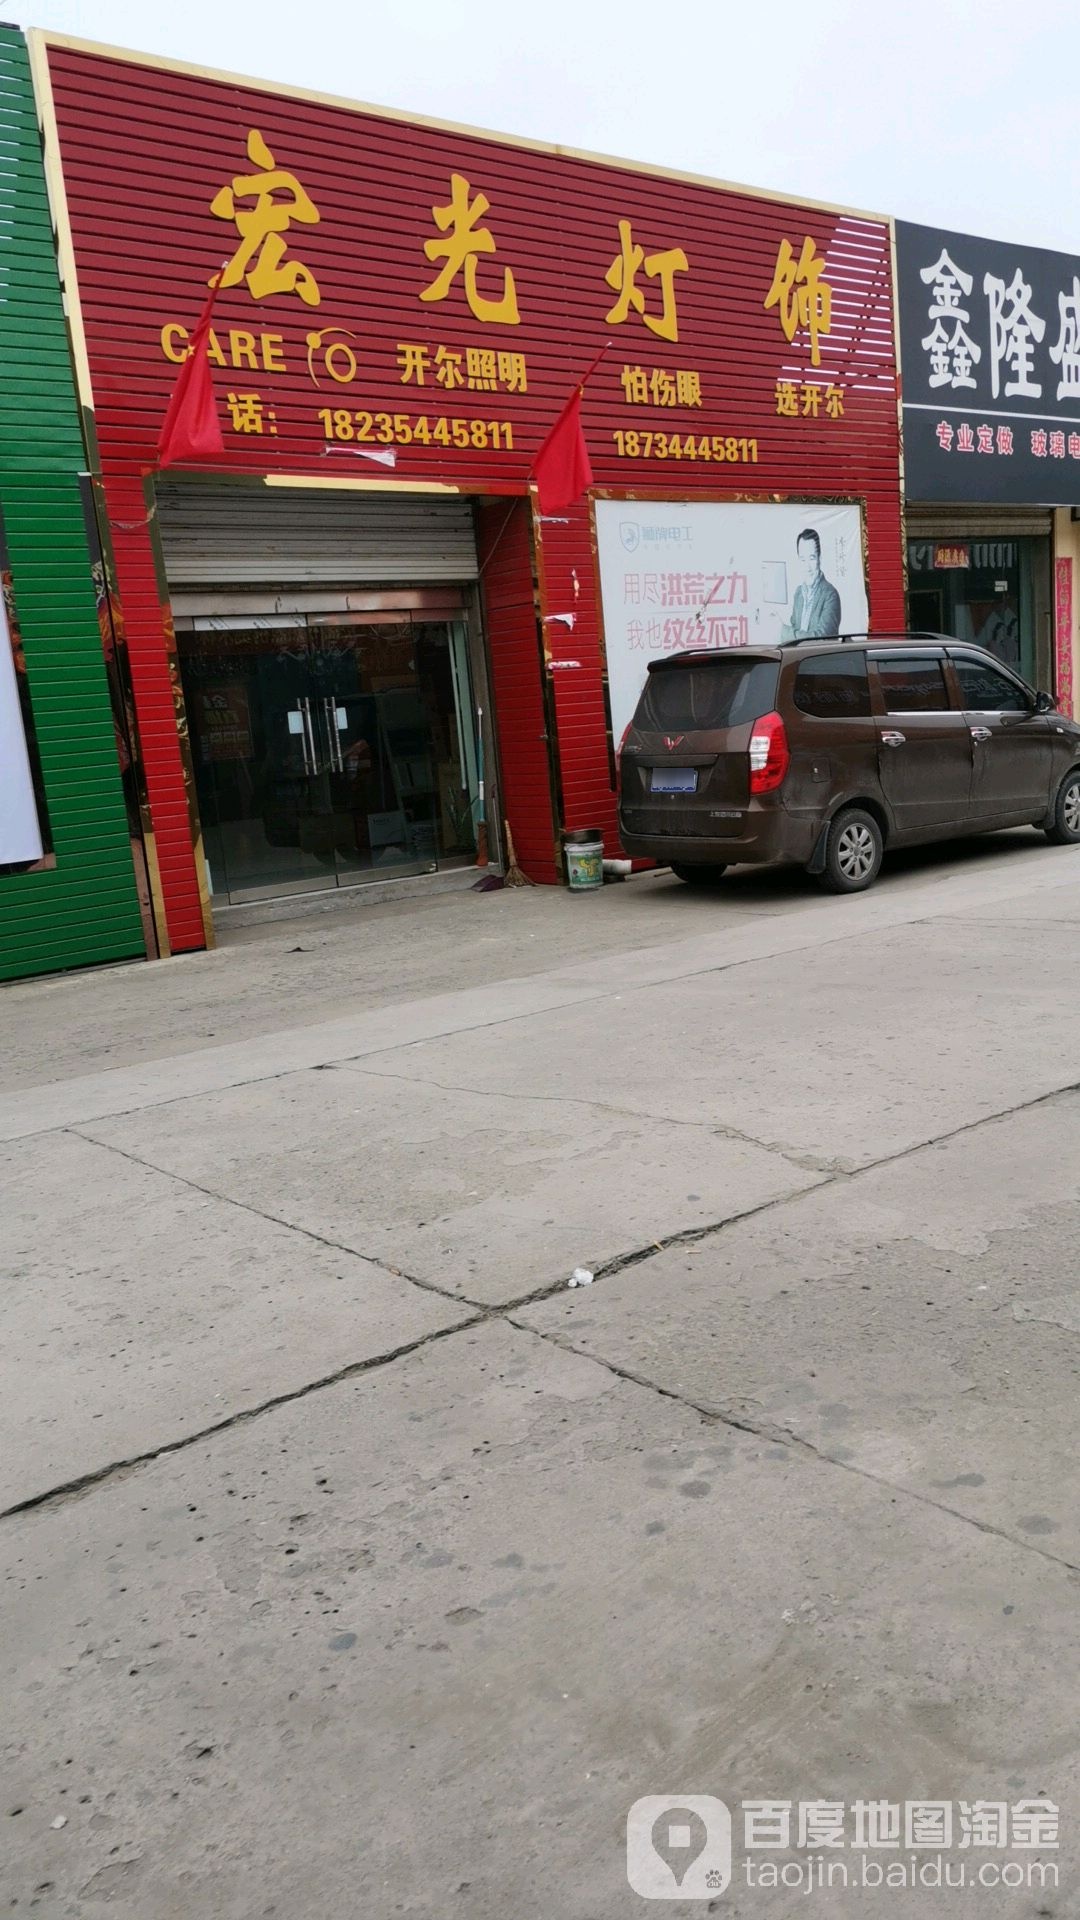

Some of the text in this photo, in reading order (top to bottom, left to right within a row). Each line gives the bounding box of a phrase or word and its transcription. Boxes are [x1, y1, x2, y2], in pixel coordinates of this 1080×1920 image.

[208, 129, 832, 366] 宏光灯饰
[160, 323, 528, 393] CARE 开尔照明
[621, 365, 844, 419] 怕伤眼 选开尔
[318, 408, 514, 450] 18235445811
[613, 430, 758, 463] 18734445811
[936, 420, 1014, 455] 专业定做
[623, 571, 749, 606] 用尽洪荒之力
[627, 615, 750, 650] 我也纹丝不动
